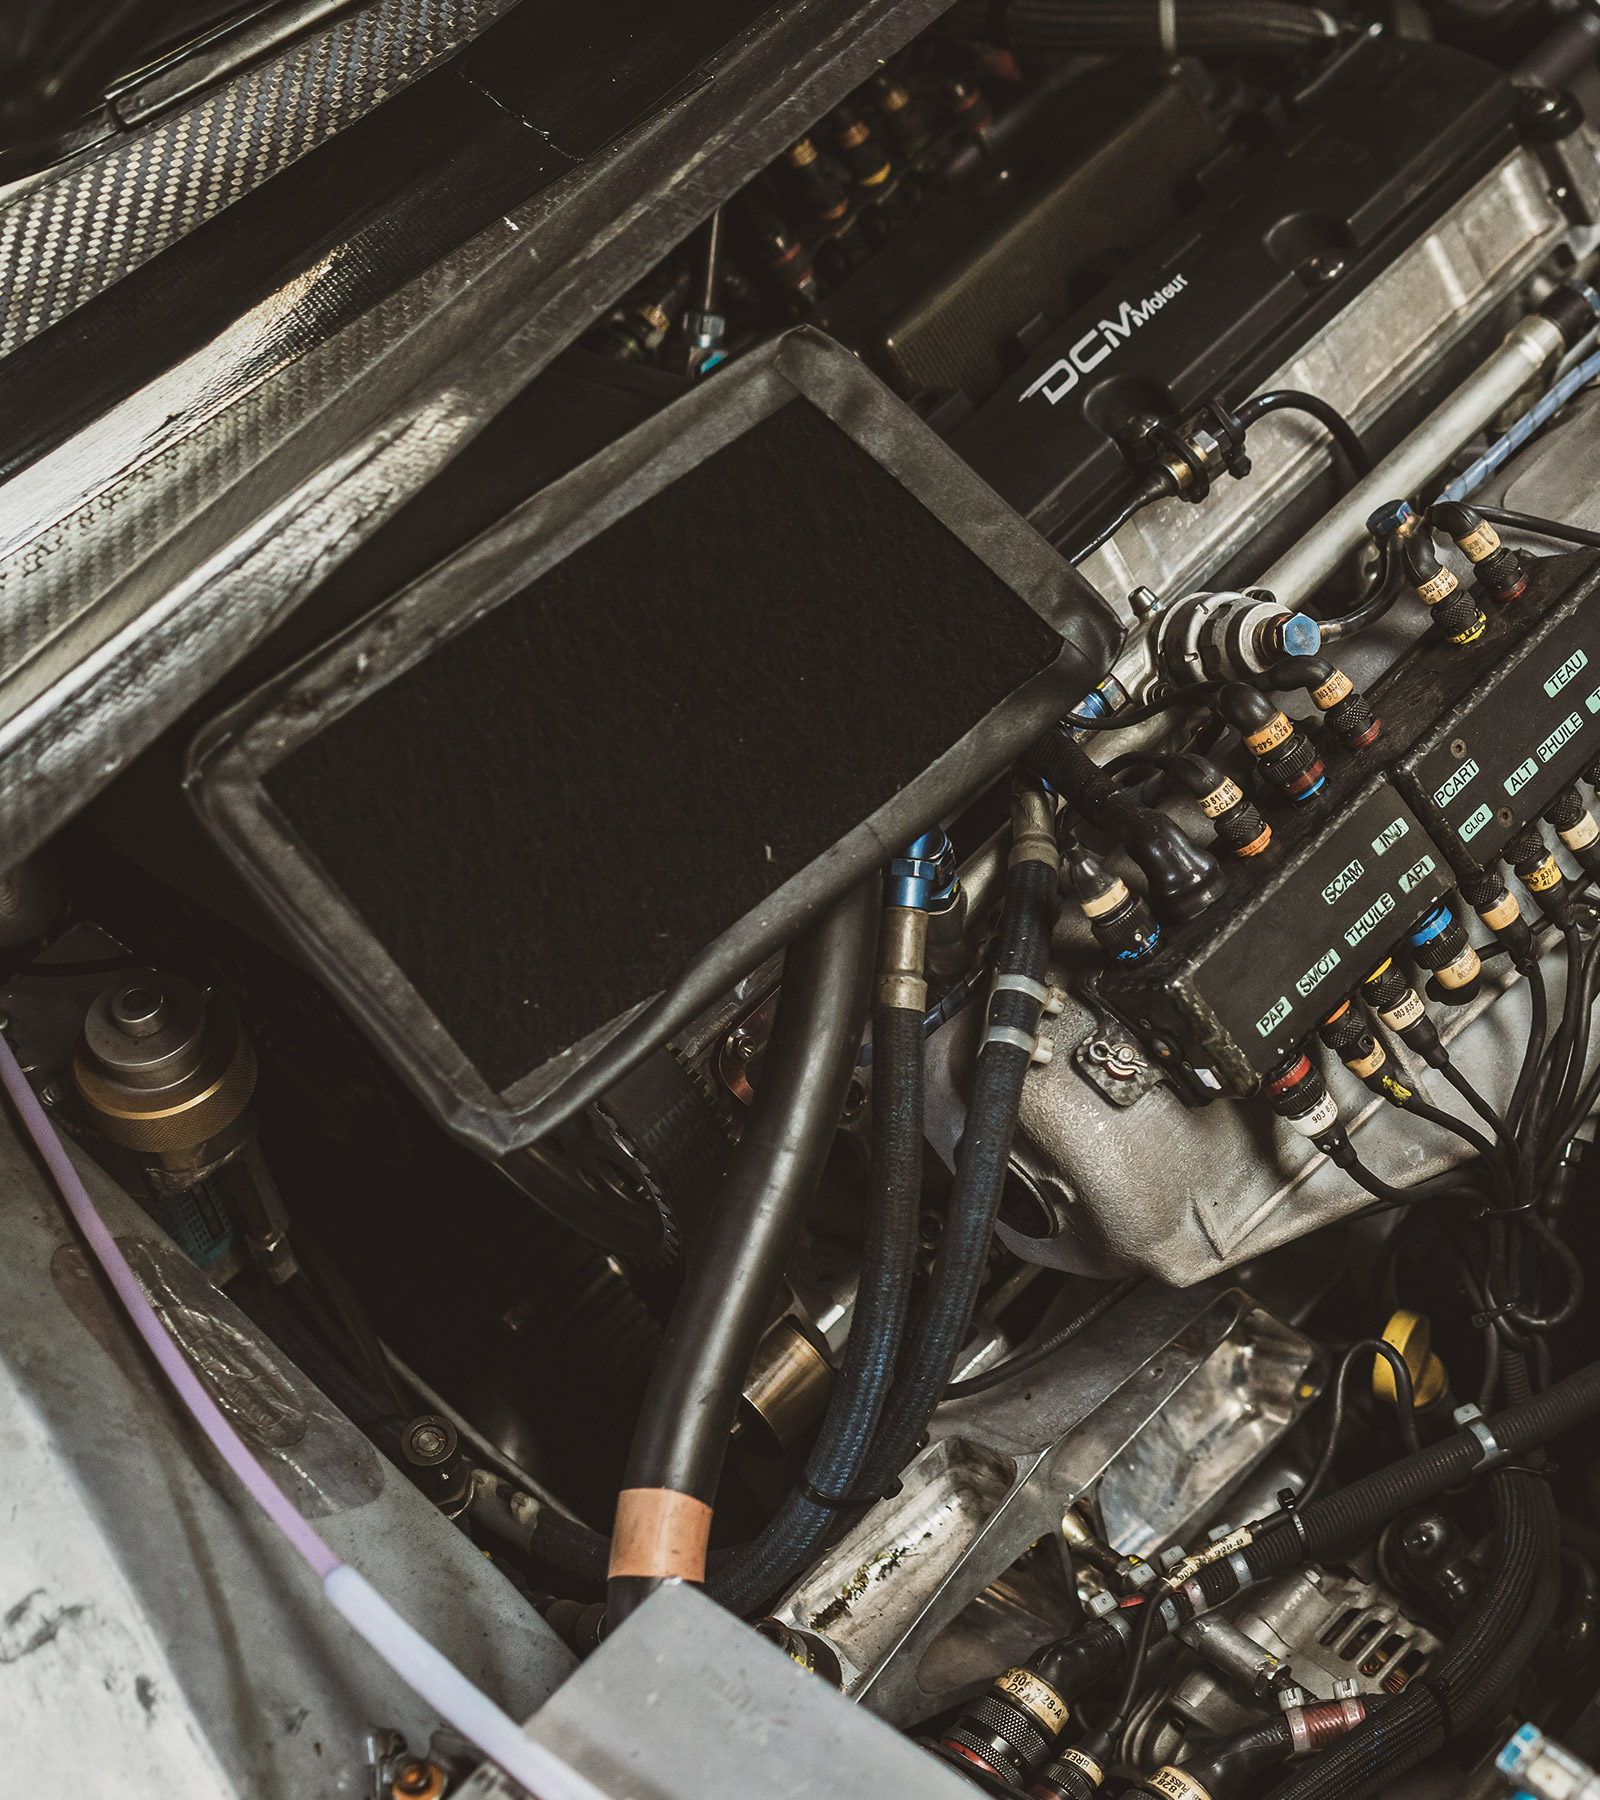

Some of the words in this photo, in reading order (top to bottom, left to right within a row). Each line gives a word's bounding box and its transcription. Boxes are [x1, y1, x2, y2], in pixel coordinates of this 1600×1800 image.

[1019, 301, 1133, 406] DCM
[1131, 273, 1188, 327] Moteur
[1548, 655, 1583, 691] TEAU
[1538, 713, 1582, 761] PHUILE
[1435, 760, 1477, 807] PCART
[1511, 762, 1532, 791] ALT
[1380, 821, 1403, 849] INJ
[1464, 811, 1486, 835] CLIQ
[1324, 861, 1363, 903] SCAM
[1406, 862, 1431, 888] API
[1346, 894, 1394, 943] THUILE
[1300, 951, 1336, 994] SMOT
[1260, 1001, 1286, 1033] PAP
[1312, 1110, 1326, 1124] 903
[1007, 1683, 1035, 1704] DEM
